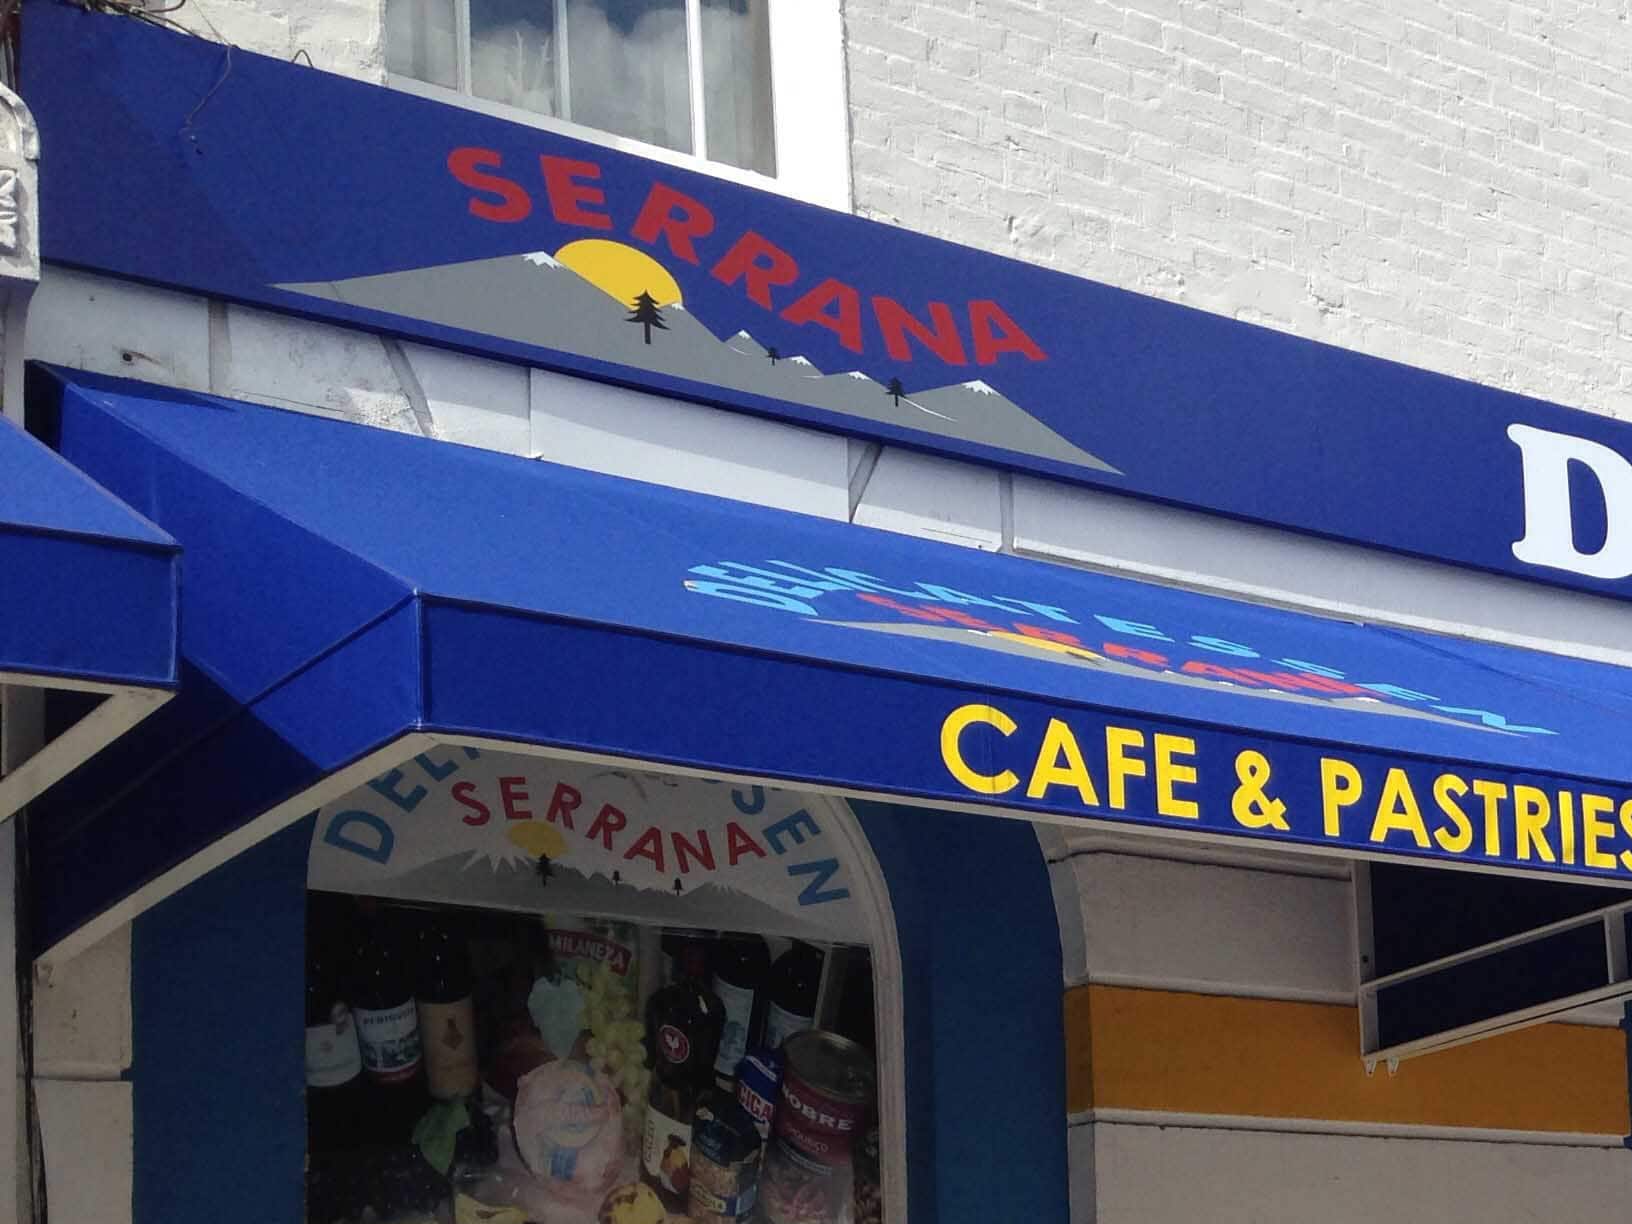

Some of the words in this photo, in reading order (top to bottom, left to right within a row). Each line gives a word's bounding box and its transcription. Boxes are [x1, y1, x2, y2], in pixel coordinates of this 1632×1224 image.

[447, 147, 1047, 366] SERRANA
[450, 775, 767, 874] SERRANA
[939, 704, 1200, 821] CAFE
[1231, 750, 1290, 832] &
